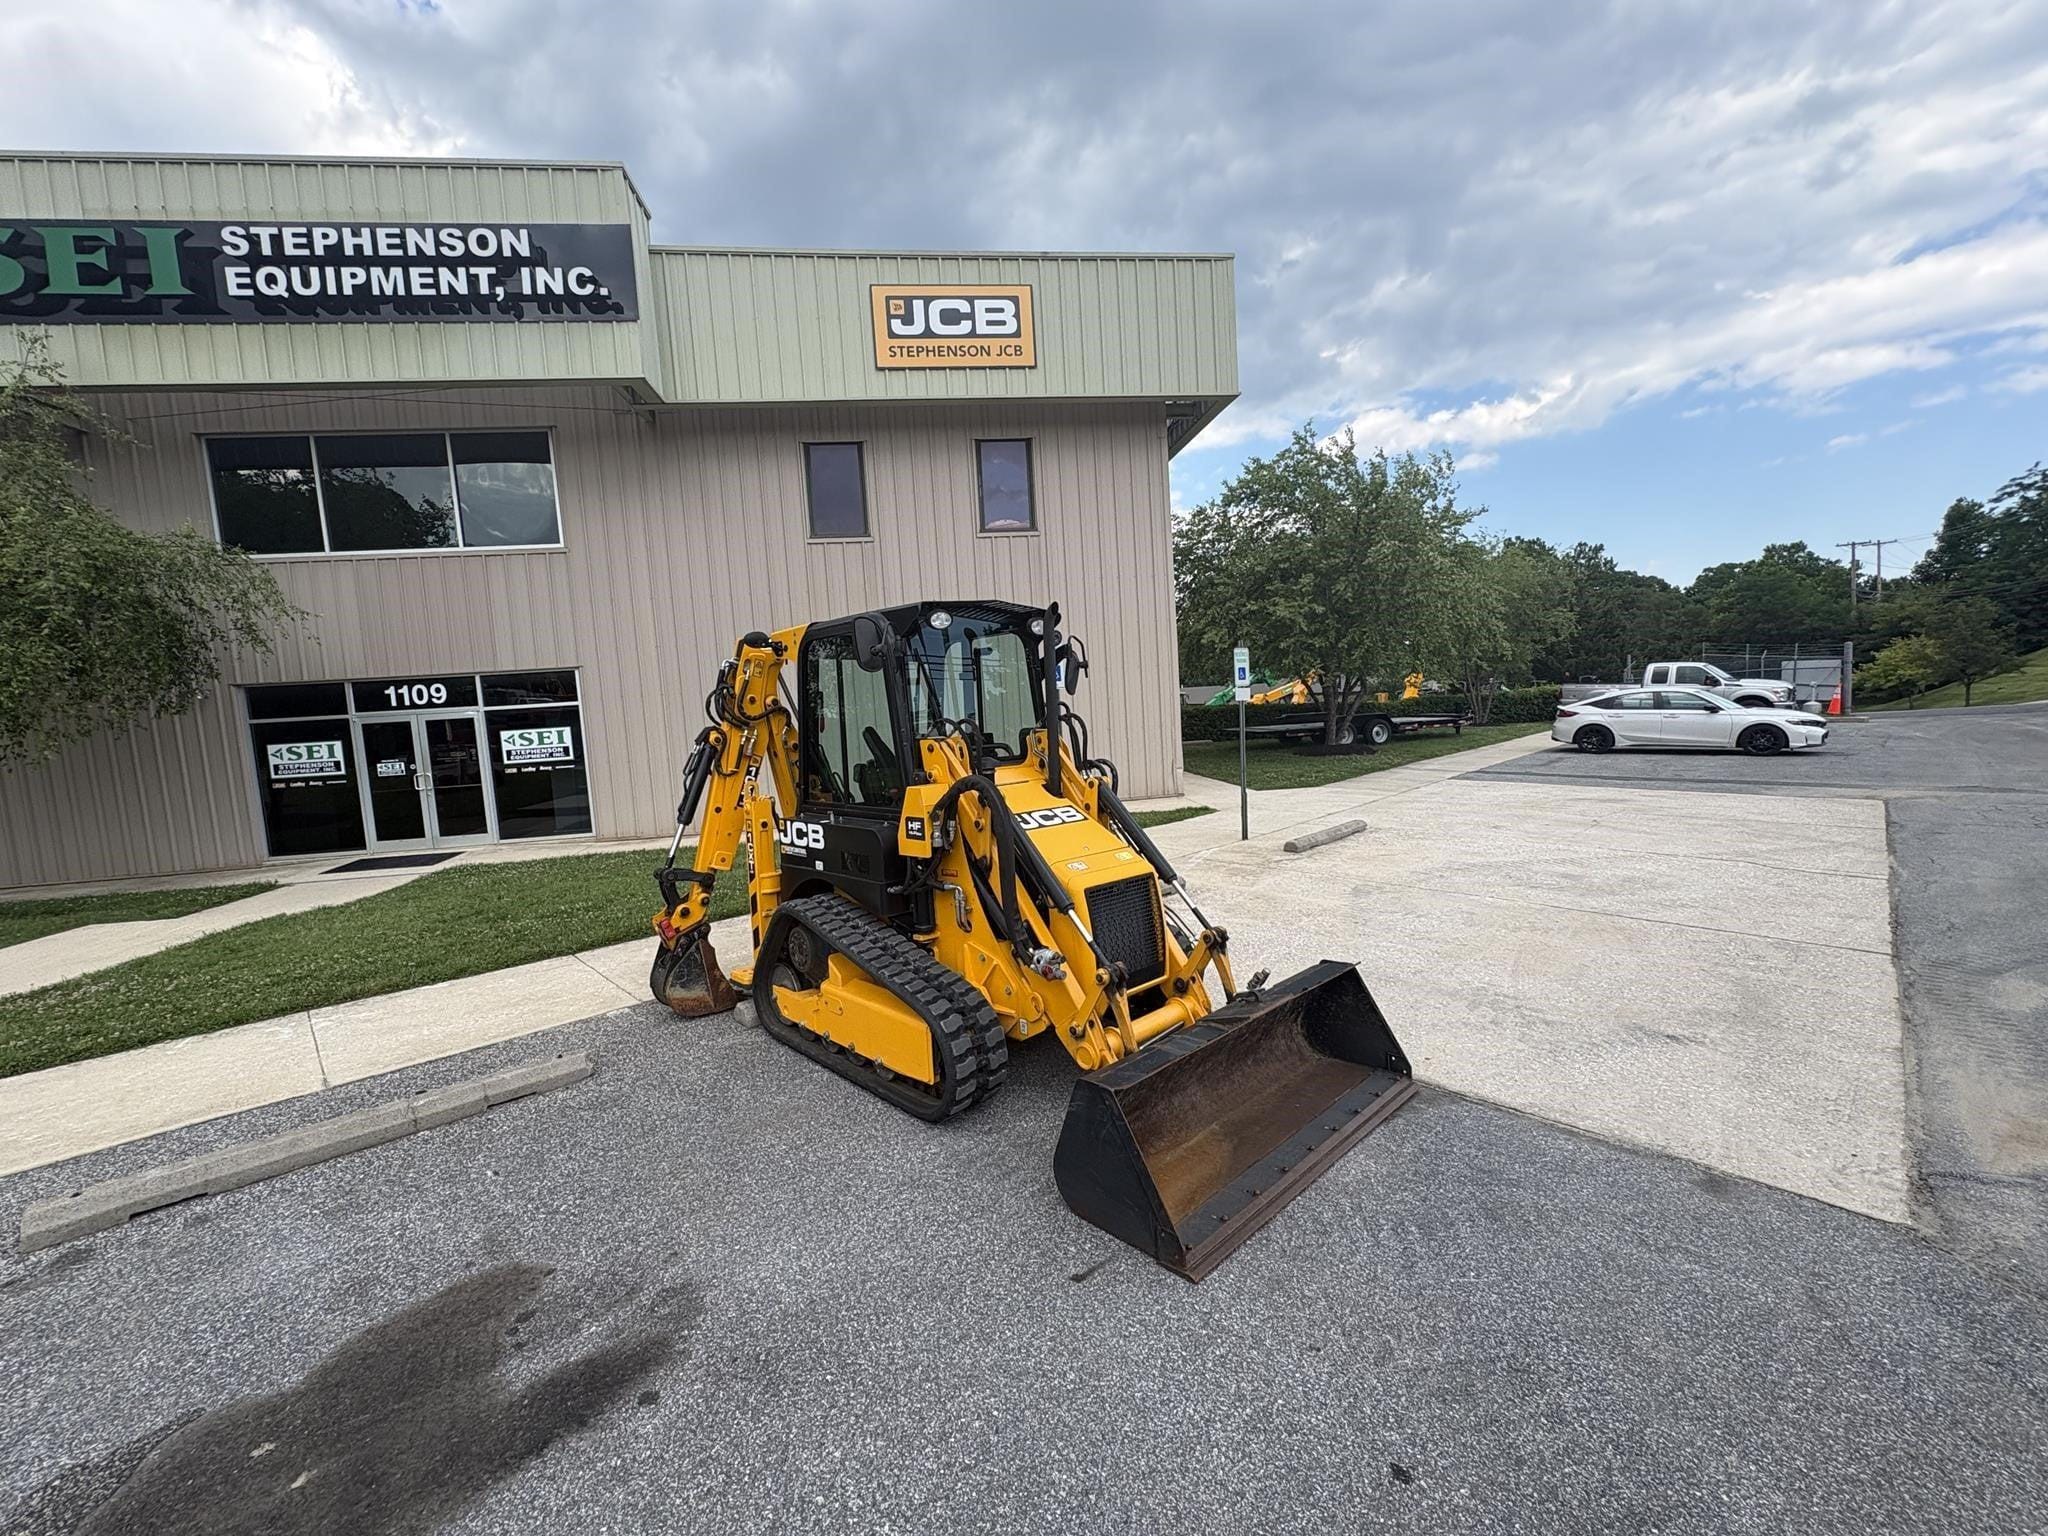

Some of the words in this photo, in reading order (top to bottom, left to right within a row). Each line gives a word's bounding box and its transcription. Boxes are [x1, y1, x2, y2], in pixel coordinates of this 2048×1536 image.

[220, 226, 531, 257] STEPHENSON
[224, 265, 505, 301] EQUIPMENT,
[520, 266, 609, 296] INC.
[890, 299, 1018, 335] JCB
[889, 344, 991, 358] STEPHENSON
[996, 344, 1023, 357] JCB
[384, 683, 447, 707] 1109
[518, 729, 567, 747] SEI
[285, 743, 338, 761] SEI
[511, 747, 563, 756] STEPHENSON
[278, 761, 335, 770] STEPHENSON
[908, 821, 922, 830] HF
[1018, 806, 1085, 830] JCB
[780, 820, 825, 850] JCB
